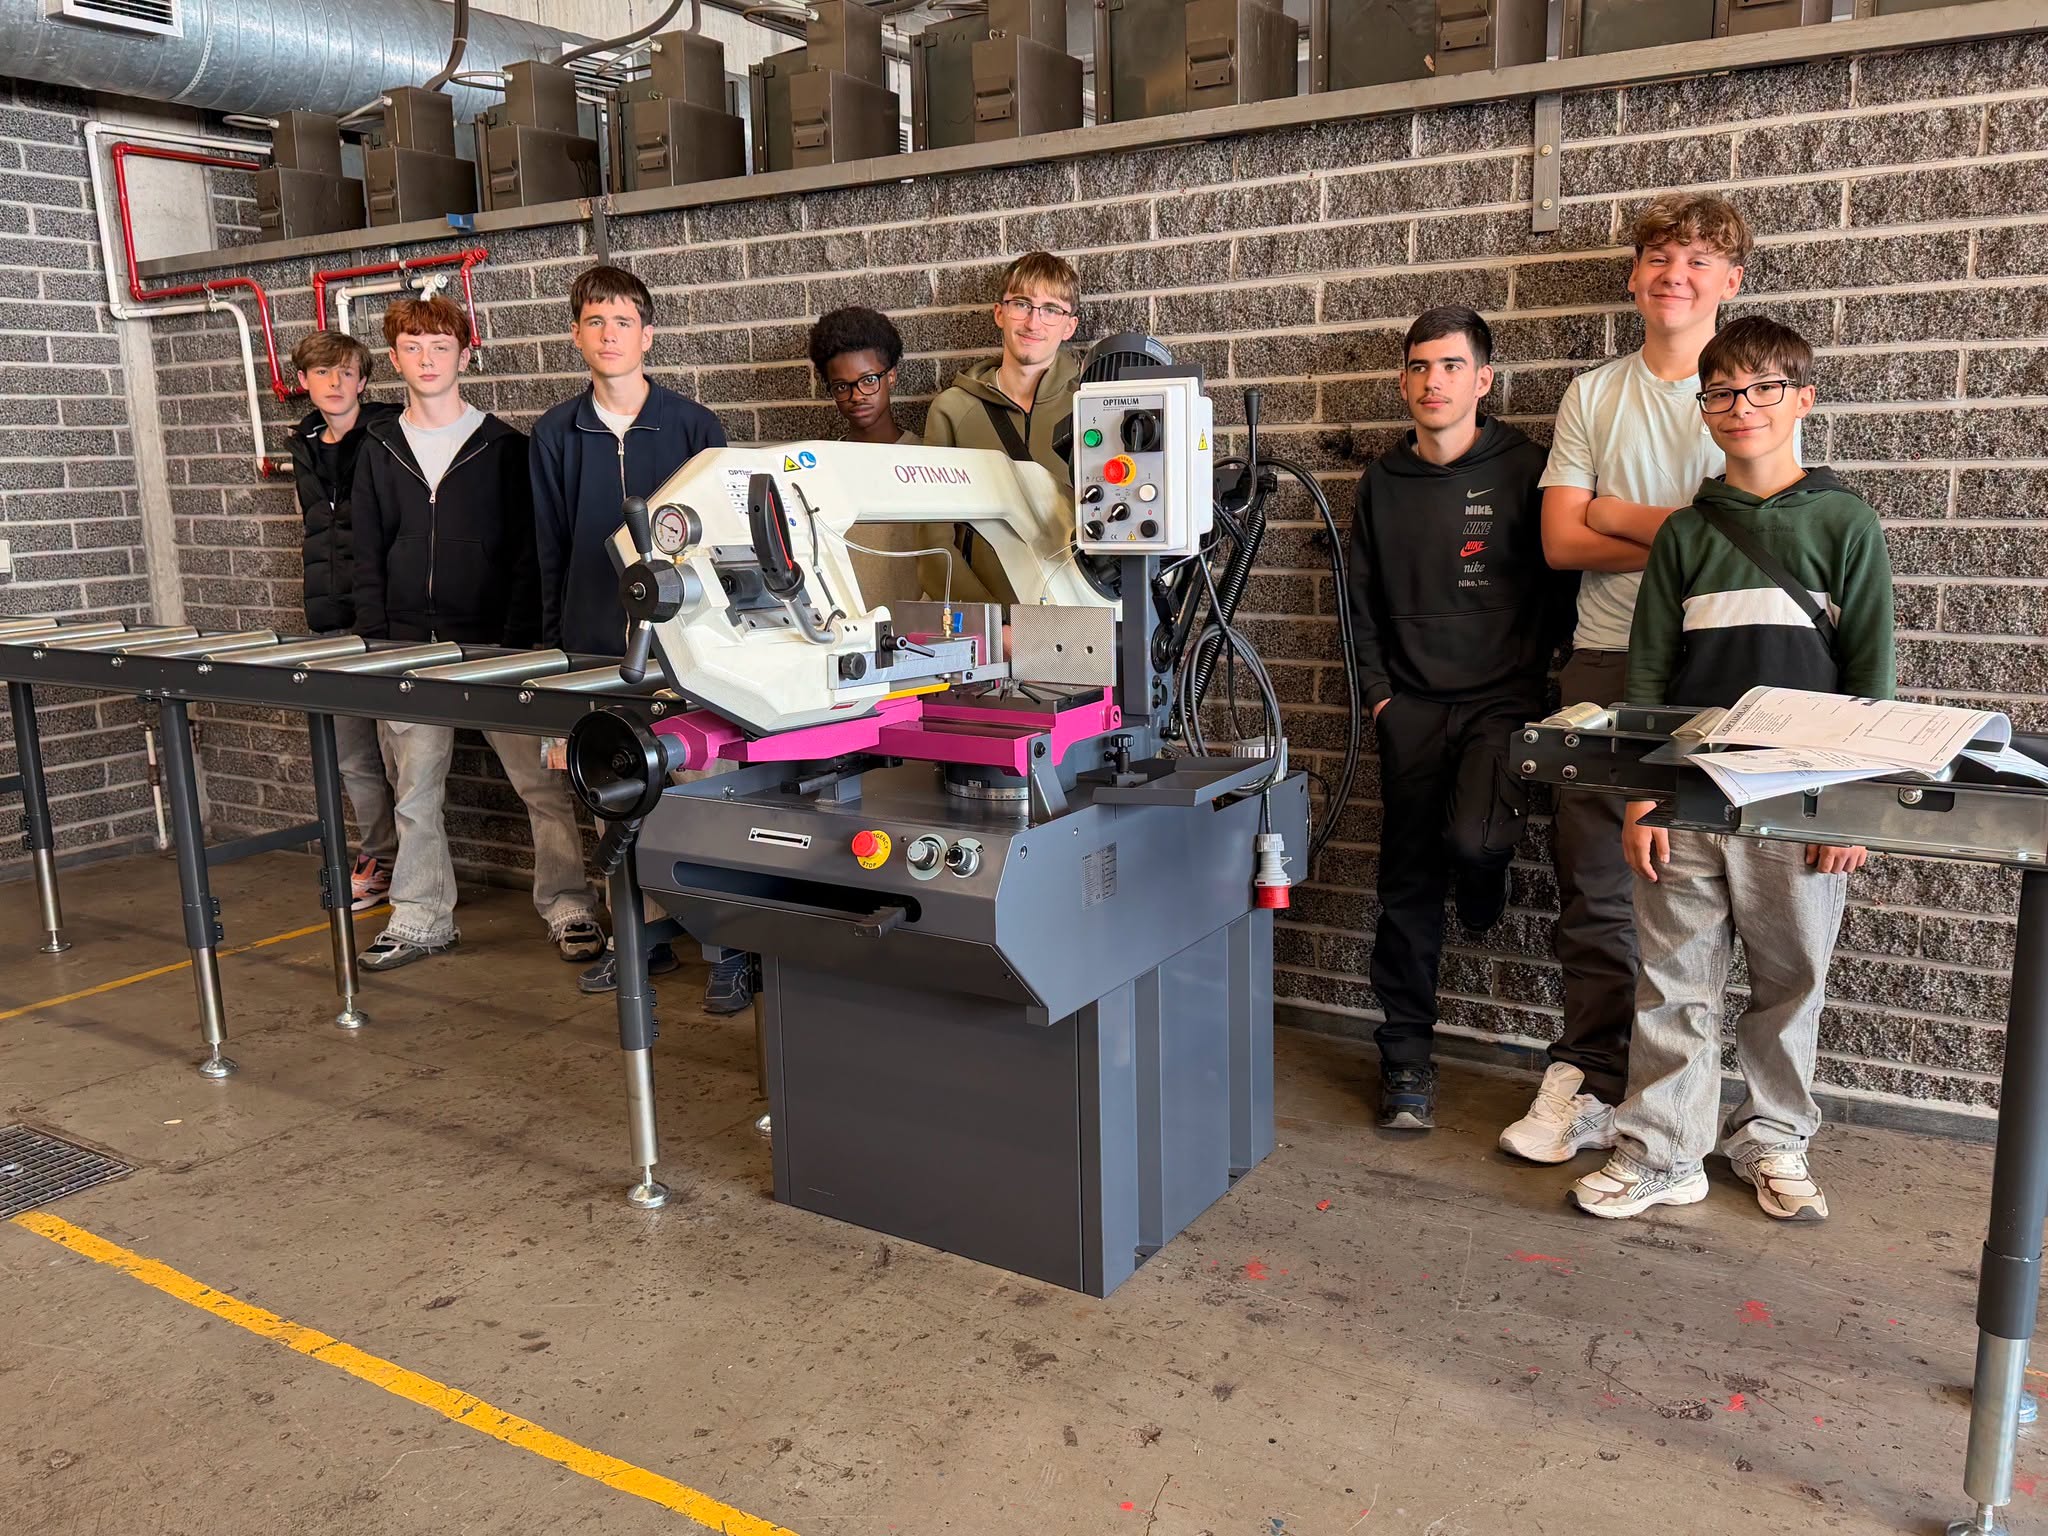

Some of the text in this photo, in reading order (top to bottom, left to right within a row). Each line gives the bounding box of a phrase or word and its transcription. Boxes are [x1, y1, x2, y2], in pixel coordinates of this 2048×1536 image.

[1103, 397, 1139, 406] OPTIMUM
[894, 465, 971, 484] OPTIMUM
[1465, 505, 1493, 515] NIKE
[1463, 521, 1493, 534] NIKE
[1465, 541, 1485, 550] NIKE
[1464, 561, 1486, 573] nike
[1458, 580, 1478, 588] Nike,
